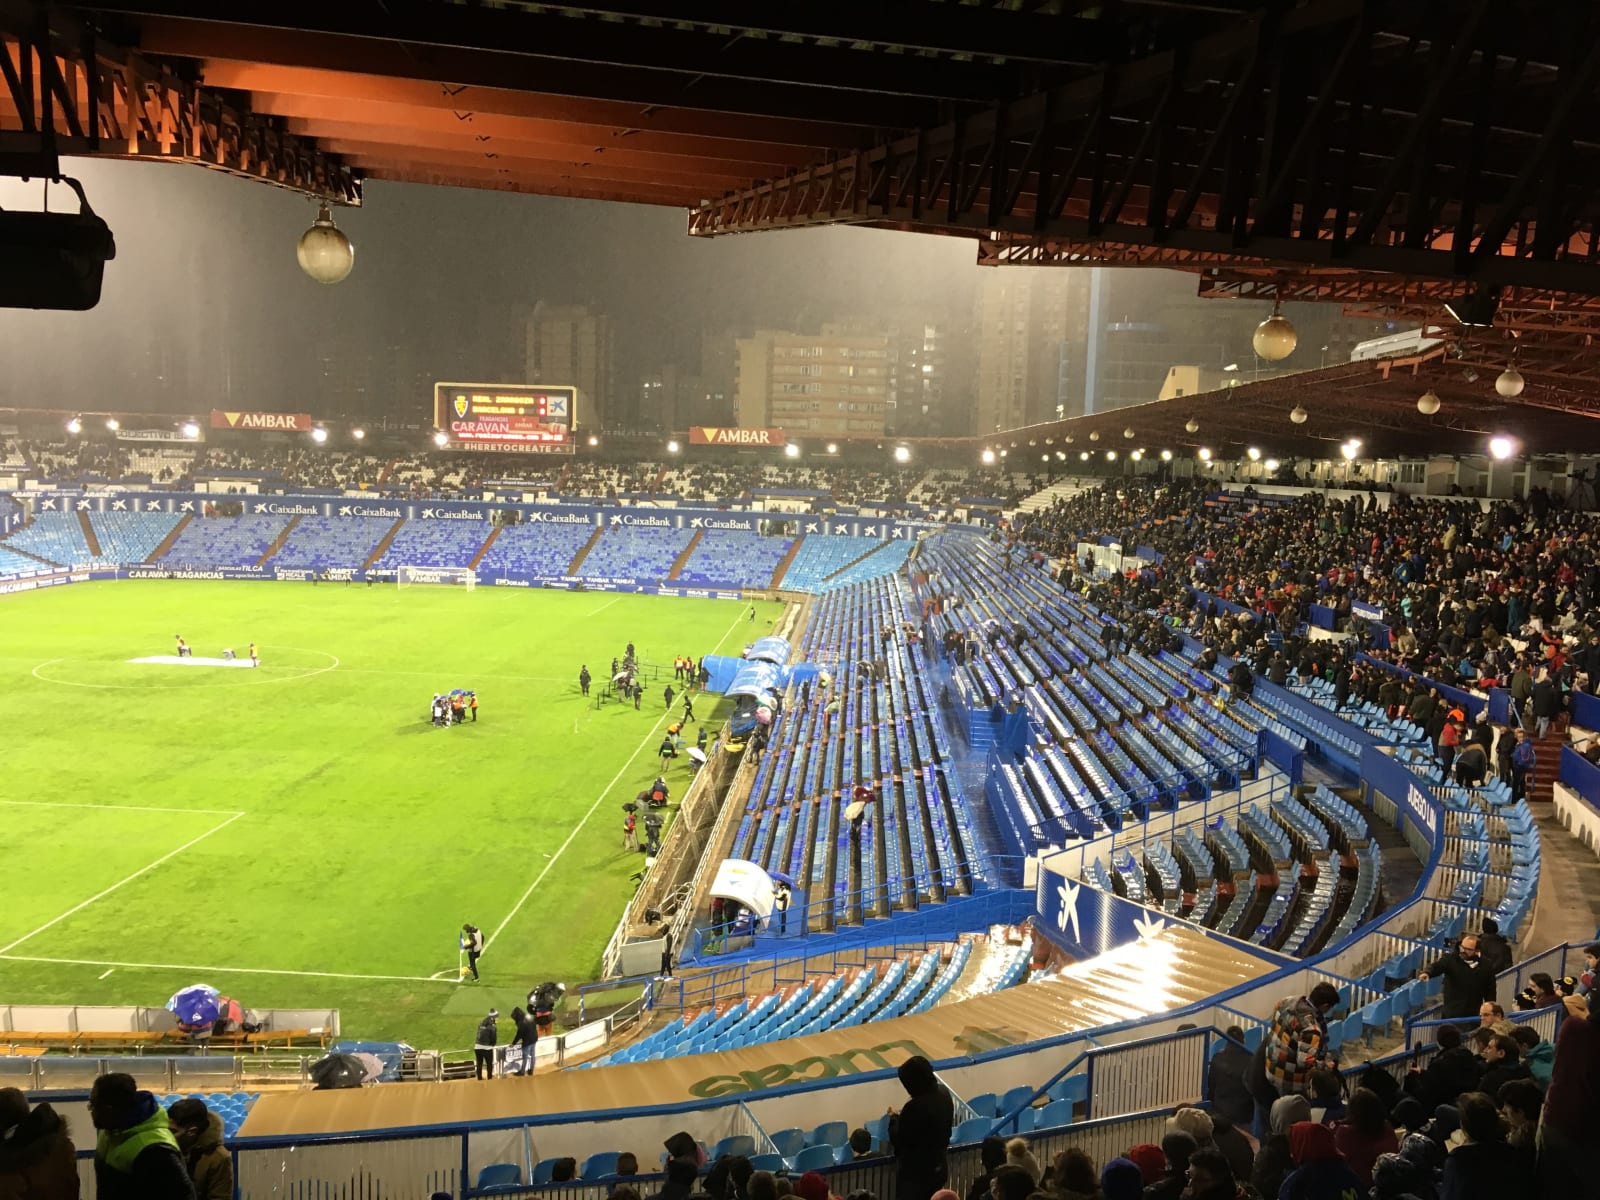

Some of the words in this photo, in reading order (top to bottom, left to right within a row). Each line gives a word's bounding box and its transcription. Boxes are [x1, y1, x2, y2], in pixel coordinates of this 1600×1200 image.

[242, 414, 298, 428] AMBAR
[452, 421, 509, 433] CARAVAN
[718, 429, 770, 443] AMBAR
[464, 443, 551, 452] #HERETOCREATE
[269, 504, 318, 515] CaixaBank
[353, 506, 401, 517] CaixaBank
[435, 509, 483, 520] CaixaBank
[543, 512, 590, 524] CaixaBank
[623, 515, 670, 527] CaixaBank
[704, 519, 751, 530] CaixaBank
[128, 571, 171, 579] CARAVAN
[1407, 783, 1426, 820] JUEGO
